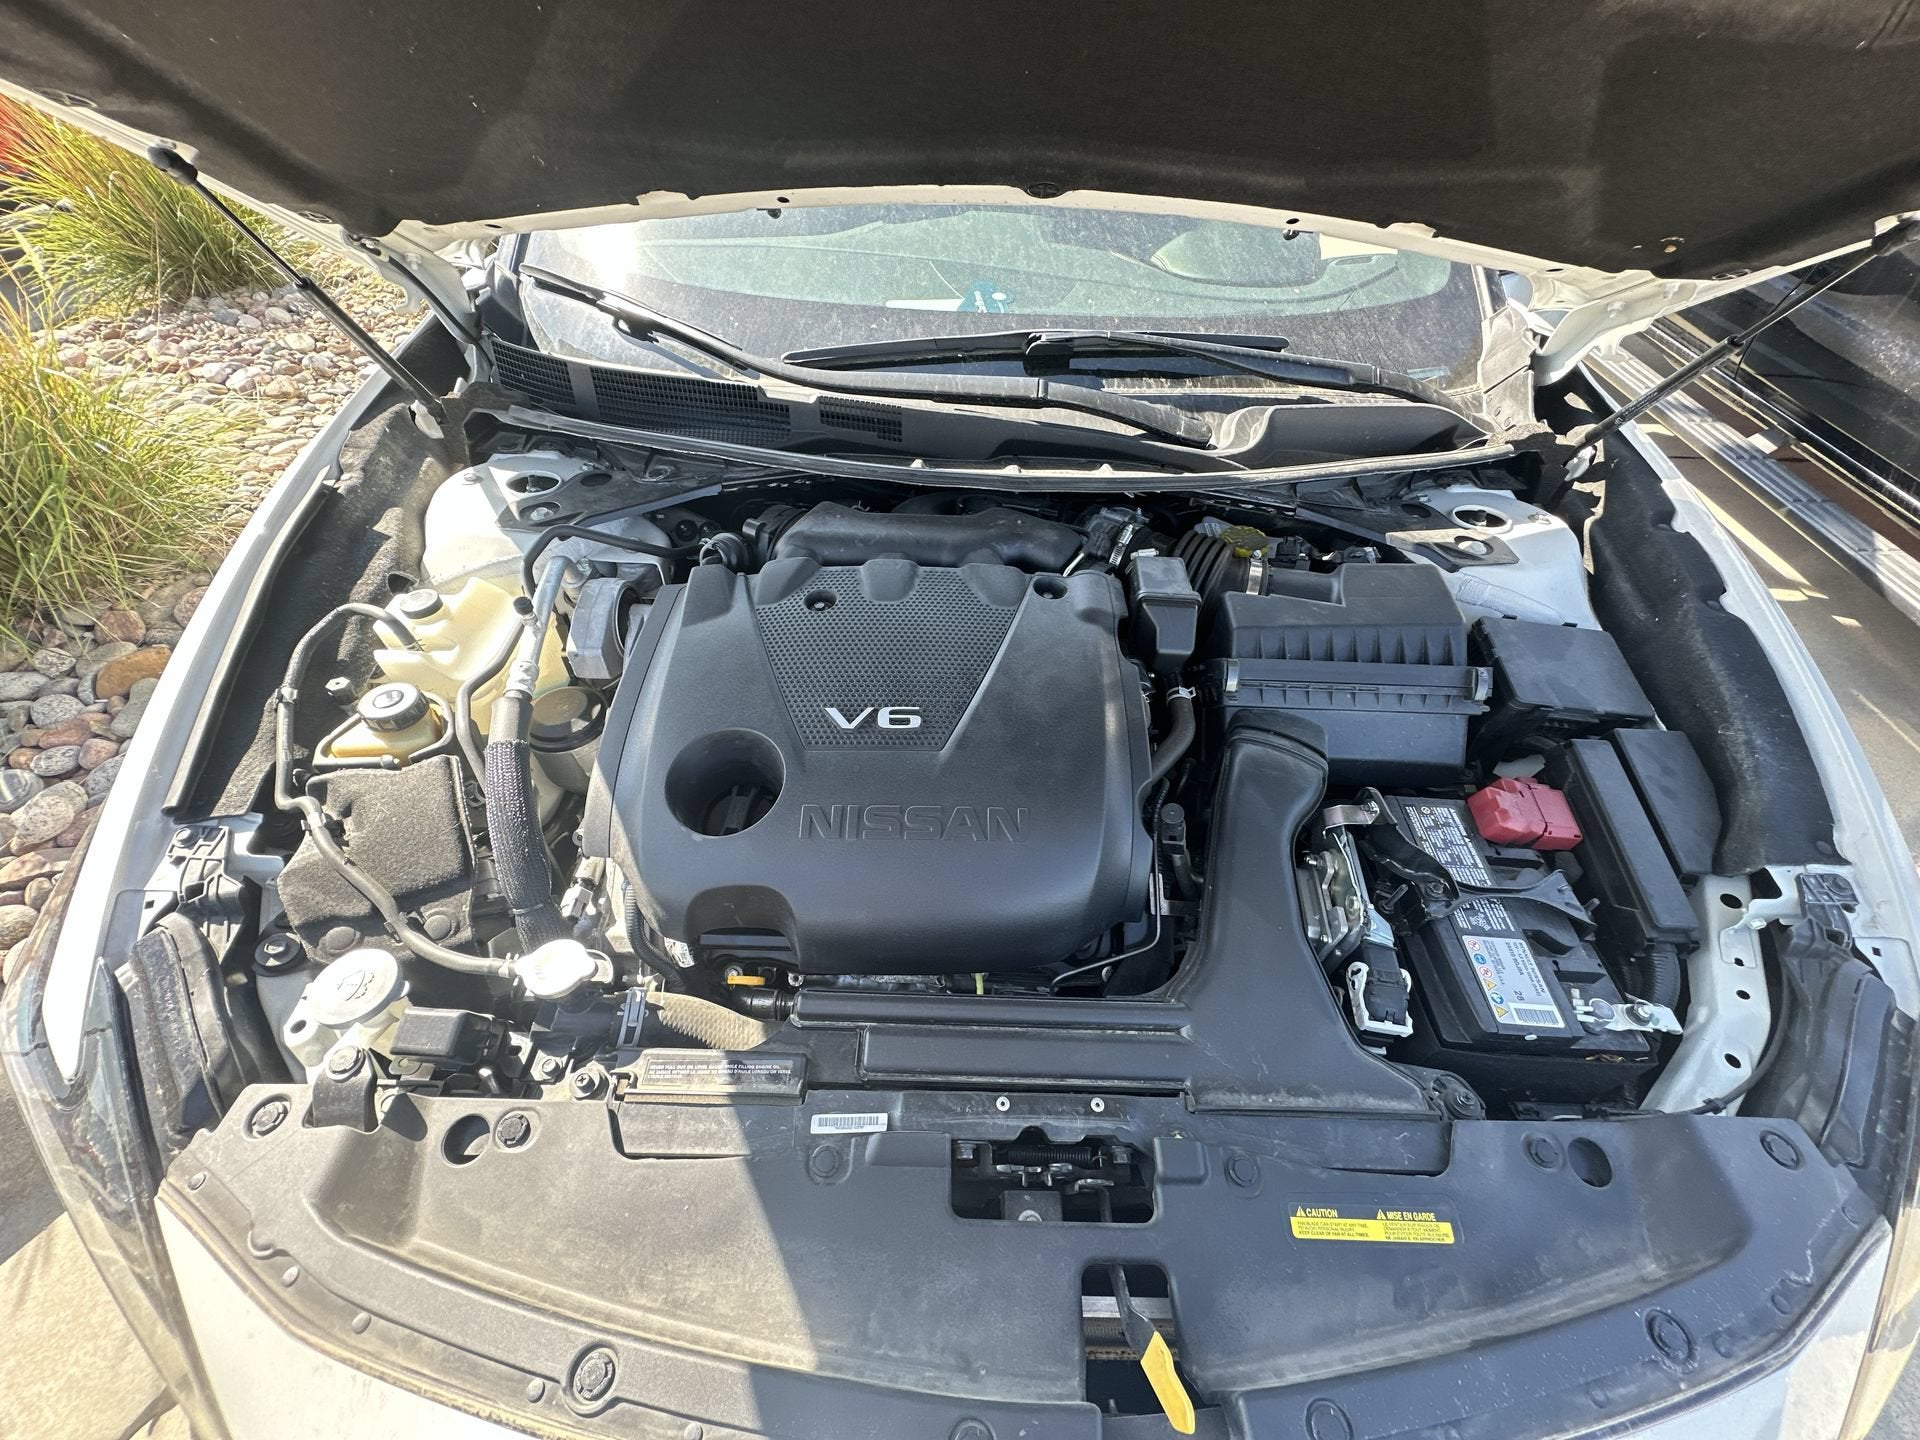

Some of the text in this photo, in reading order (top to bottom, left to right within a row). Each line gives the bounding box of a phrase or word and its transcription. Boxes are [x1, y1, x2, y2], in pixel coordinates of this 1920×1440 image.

[824, 706, 922, 729] V6
[798, 803, 1029, 842] NISSAN
[1513, 990, 1525, 1000] 28
[1306, 1208, 1338, 1217] CAUTION
[1386, 1211, 1436, 1221] MISE EN GARDE
